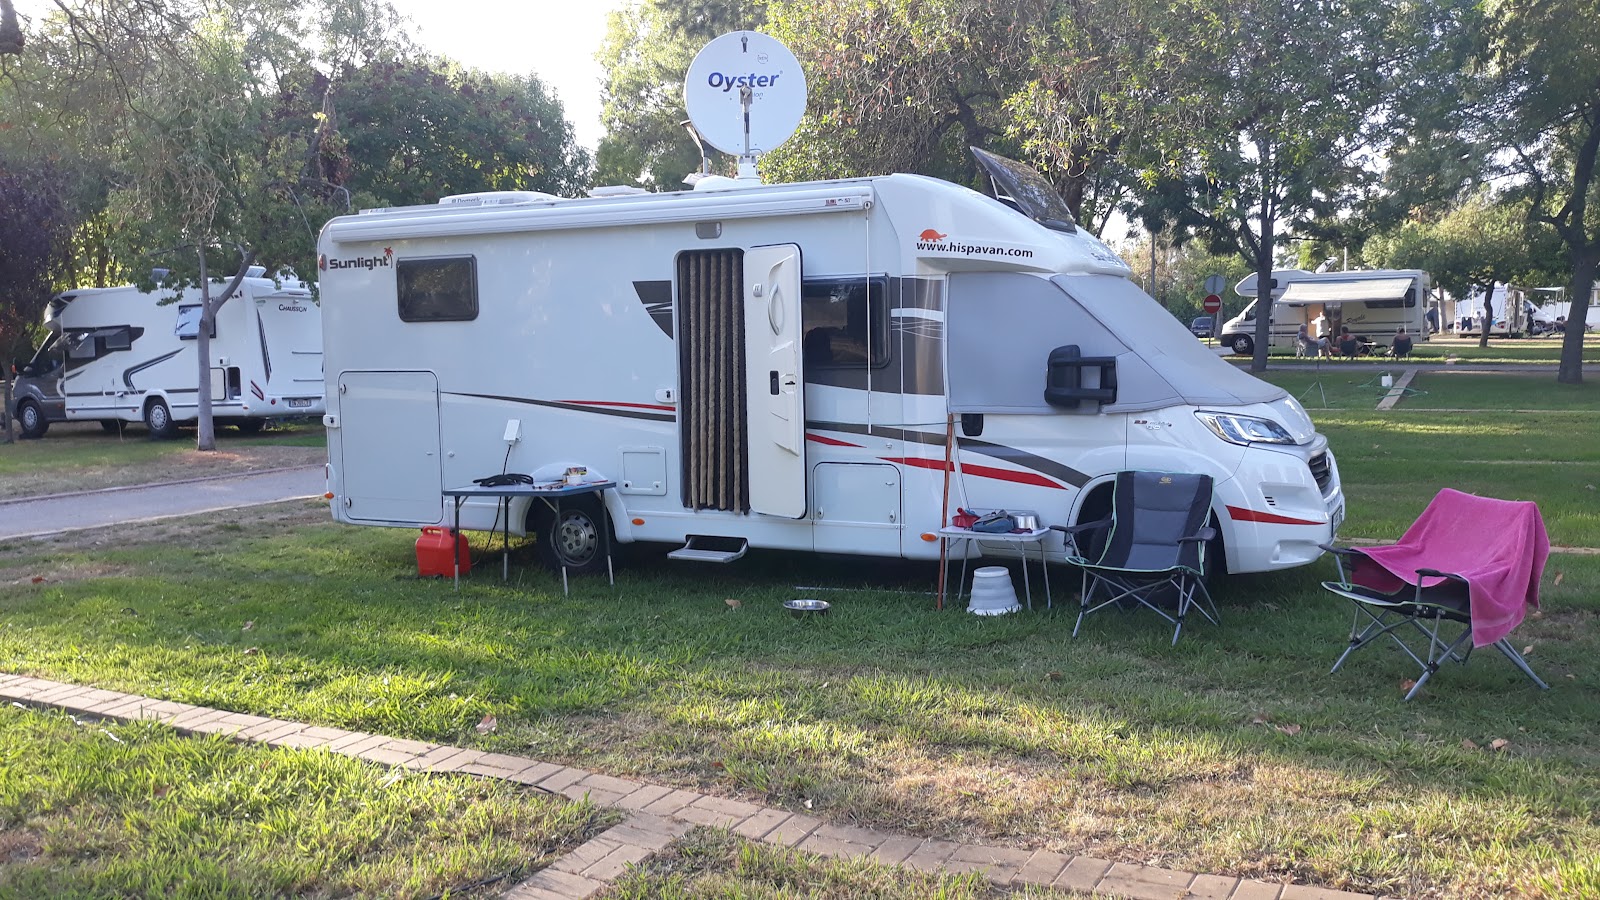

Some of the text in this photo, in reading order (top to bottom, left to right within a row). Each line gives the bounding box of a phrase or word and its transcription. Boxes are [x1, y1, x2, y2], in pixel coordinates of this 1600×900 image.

[708, 72, 780, 92] Oyster
[916, 242, 1033, 258] www.hispavan.com
[329, 256, 388, 270] Sunlight
